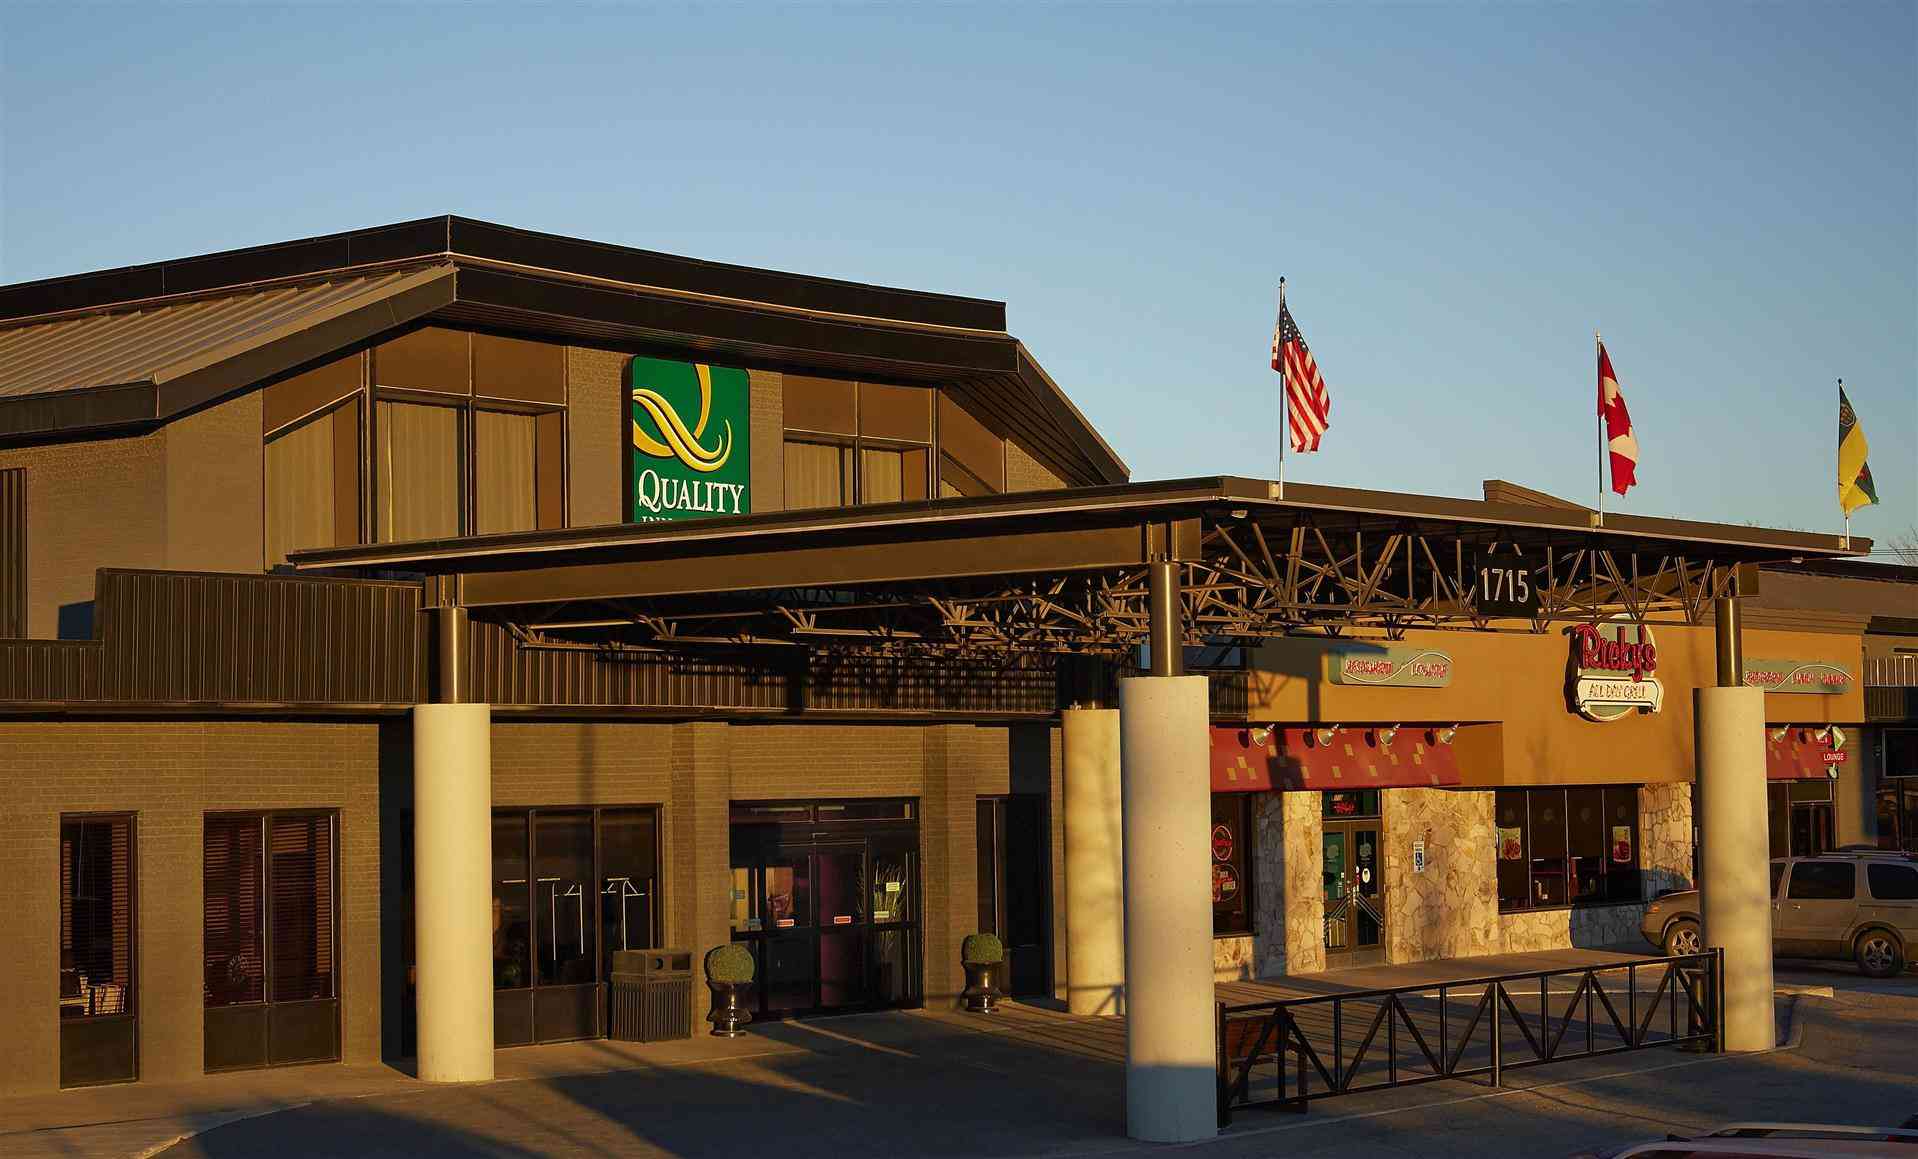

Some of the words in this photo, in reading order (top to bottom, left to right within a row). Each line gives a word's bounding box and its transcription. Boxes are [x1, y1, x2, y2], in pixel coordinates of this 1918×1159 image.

[638, 469, 745, 514] QUALITY
[1481, 567, 1529, 603] 1715
[1823, 752, 1845, 761] LOUNGE
